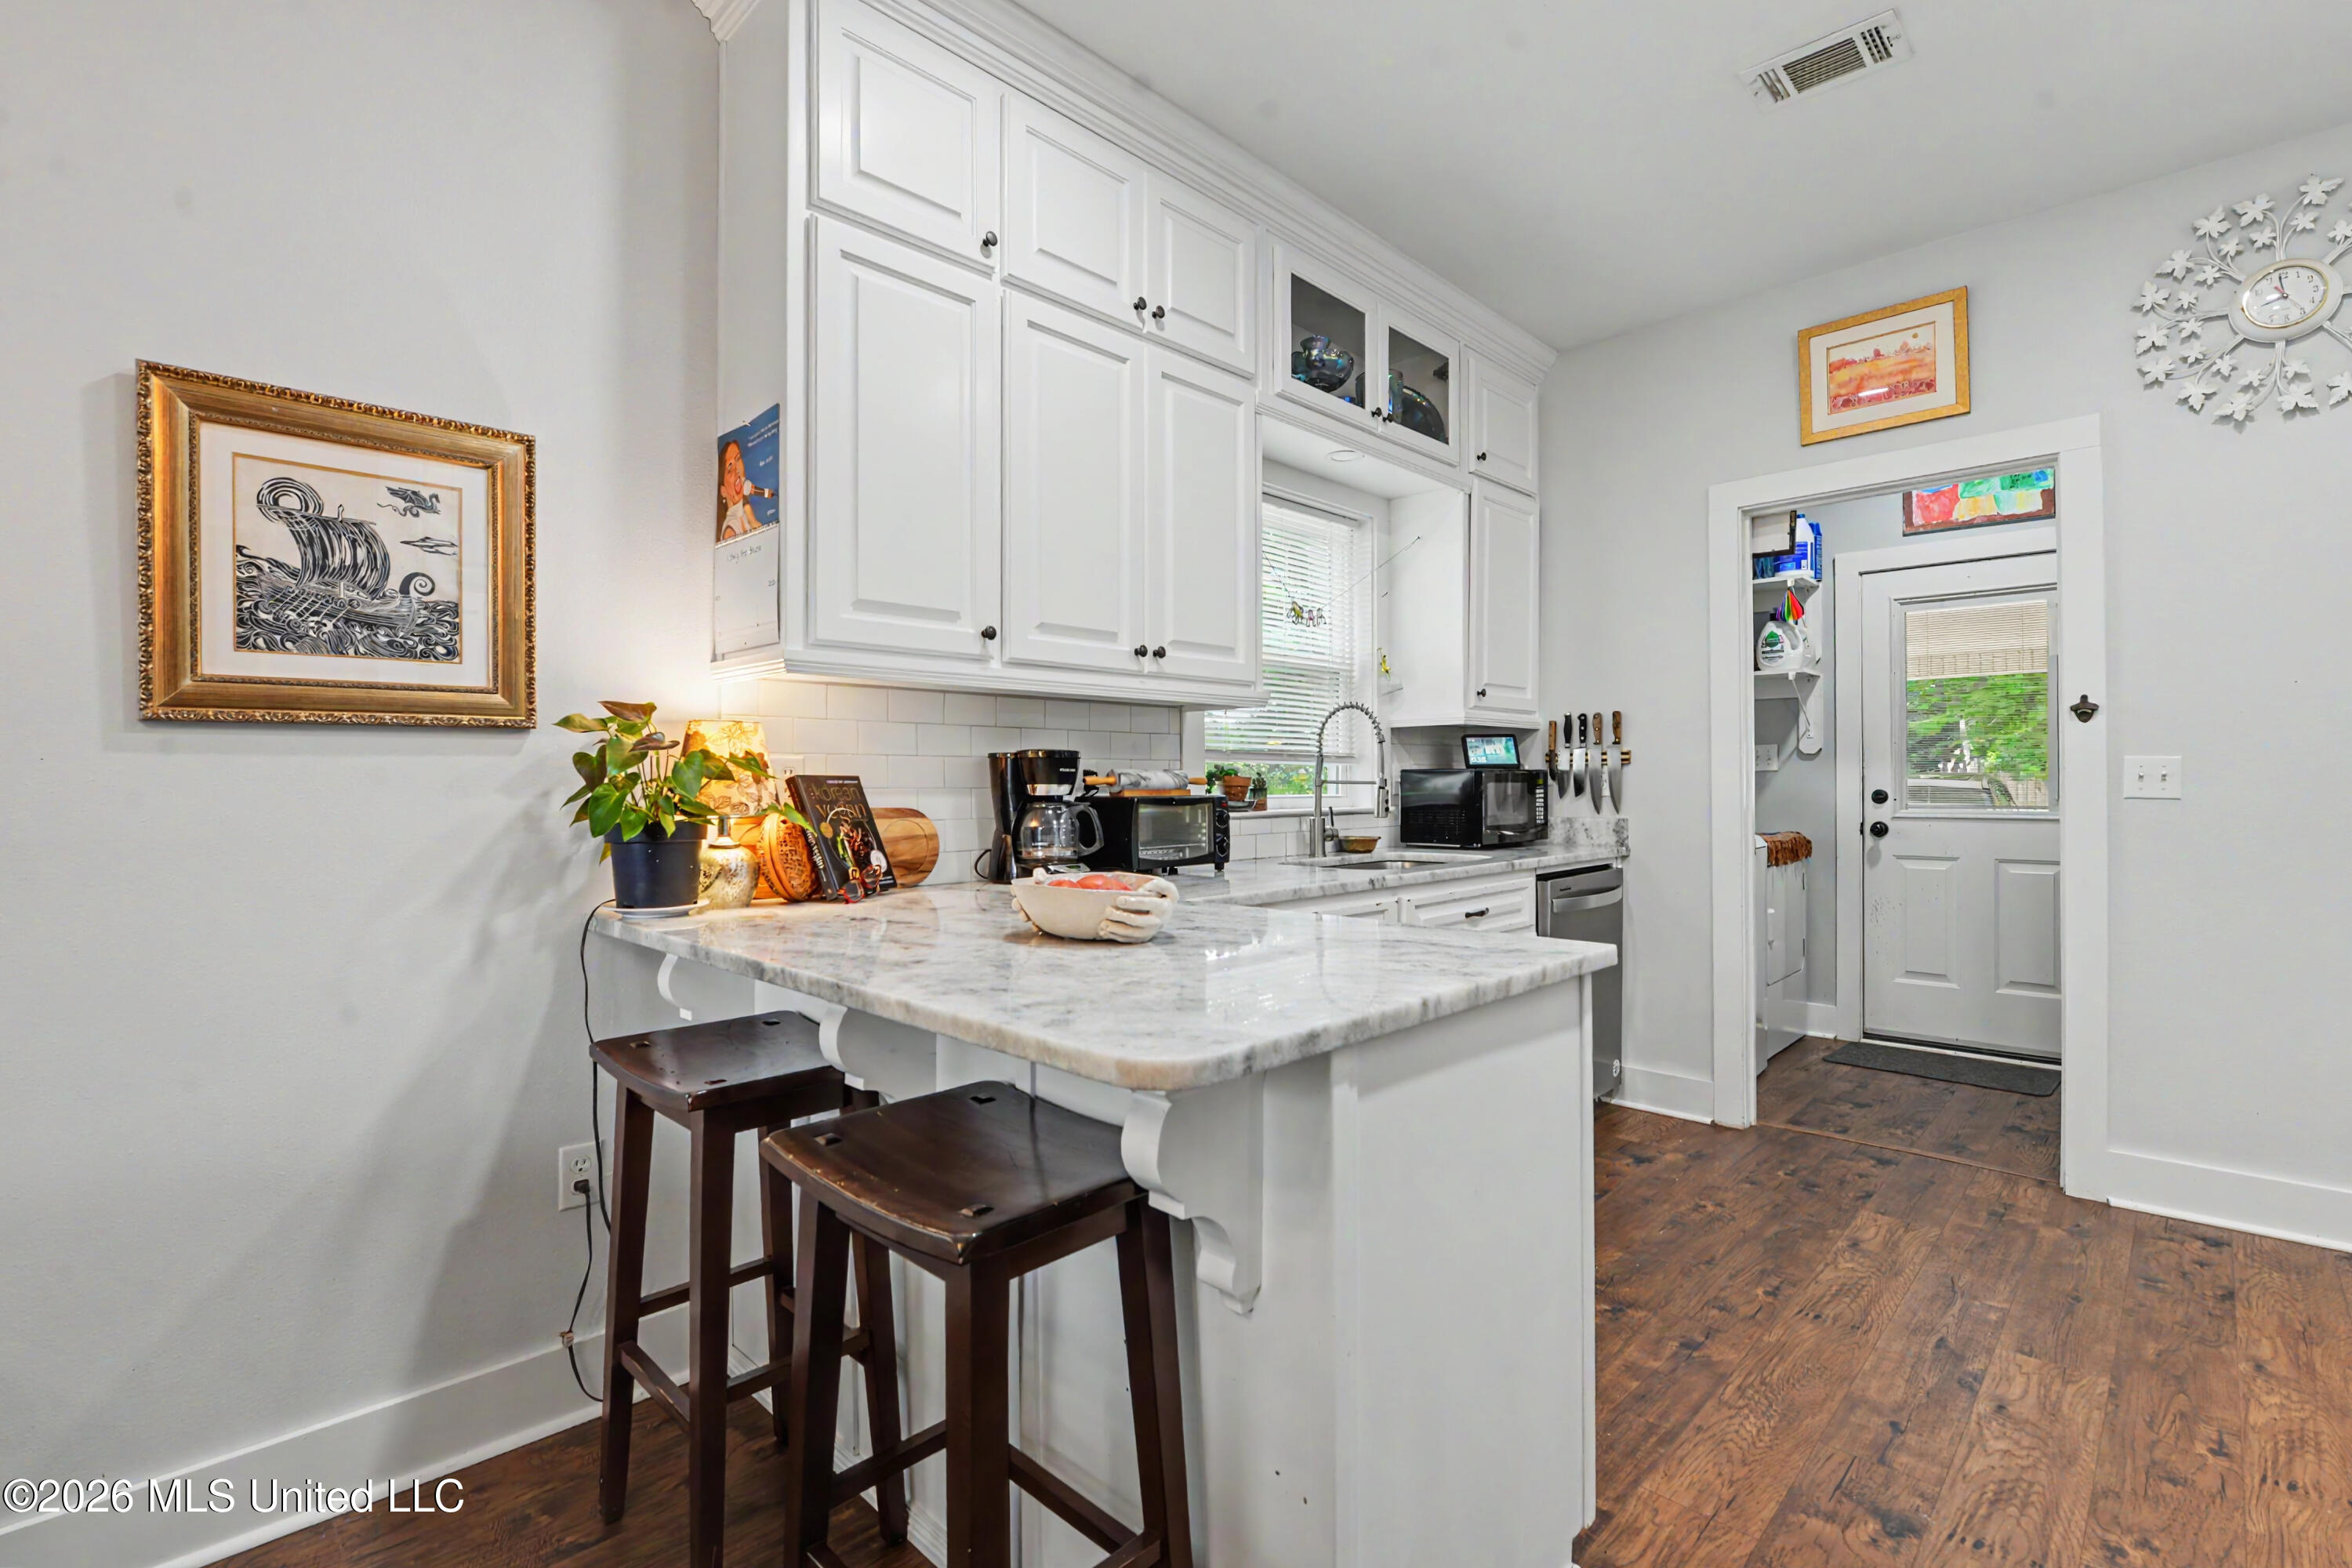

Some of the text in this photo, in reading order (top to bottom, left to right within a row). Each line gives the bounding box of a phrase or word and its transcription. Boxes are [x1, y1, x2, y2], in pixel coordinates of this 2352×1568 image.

[2307, 274, 2314, 283] 2
[811, 783, 861, 802] korean
[815, 803, 867, 822] vegan
